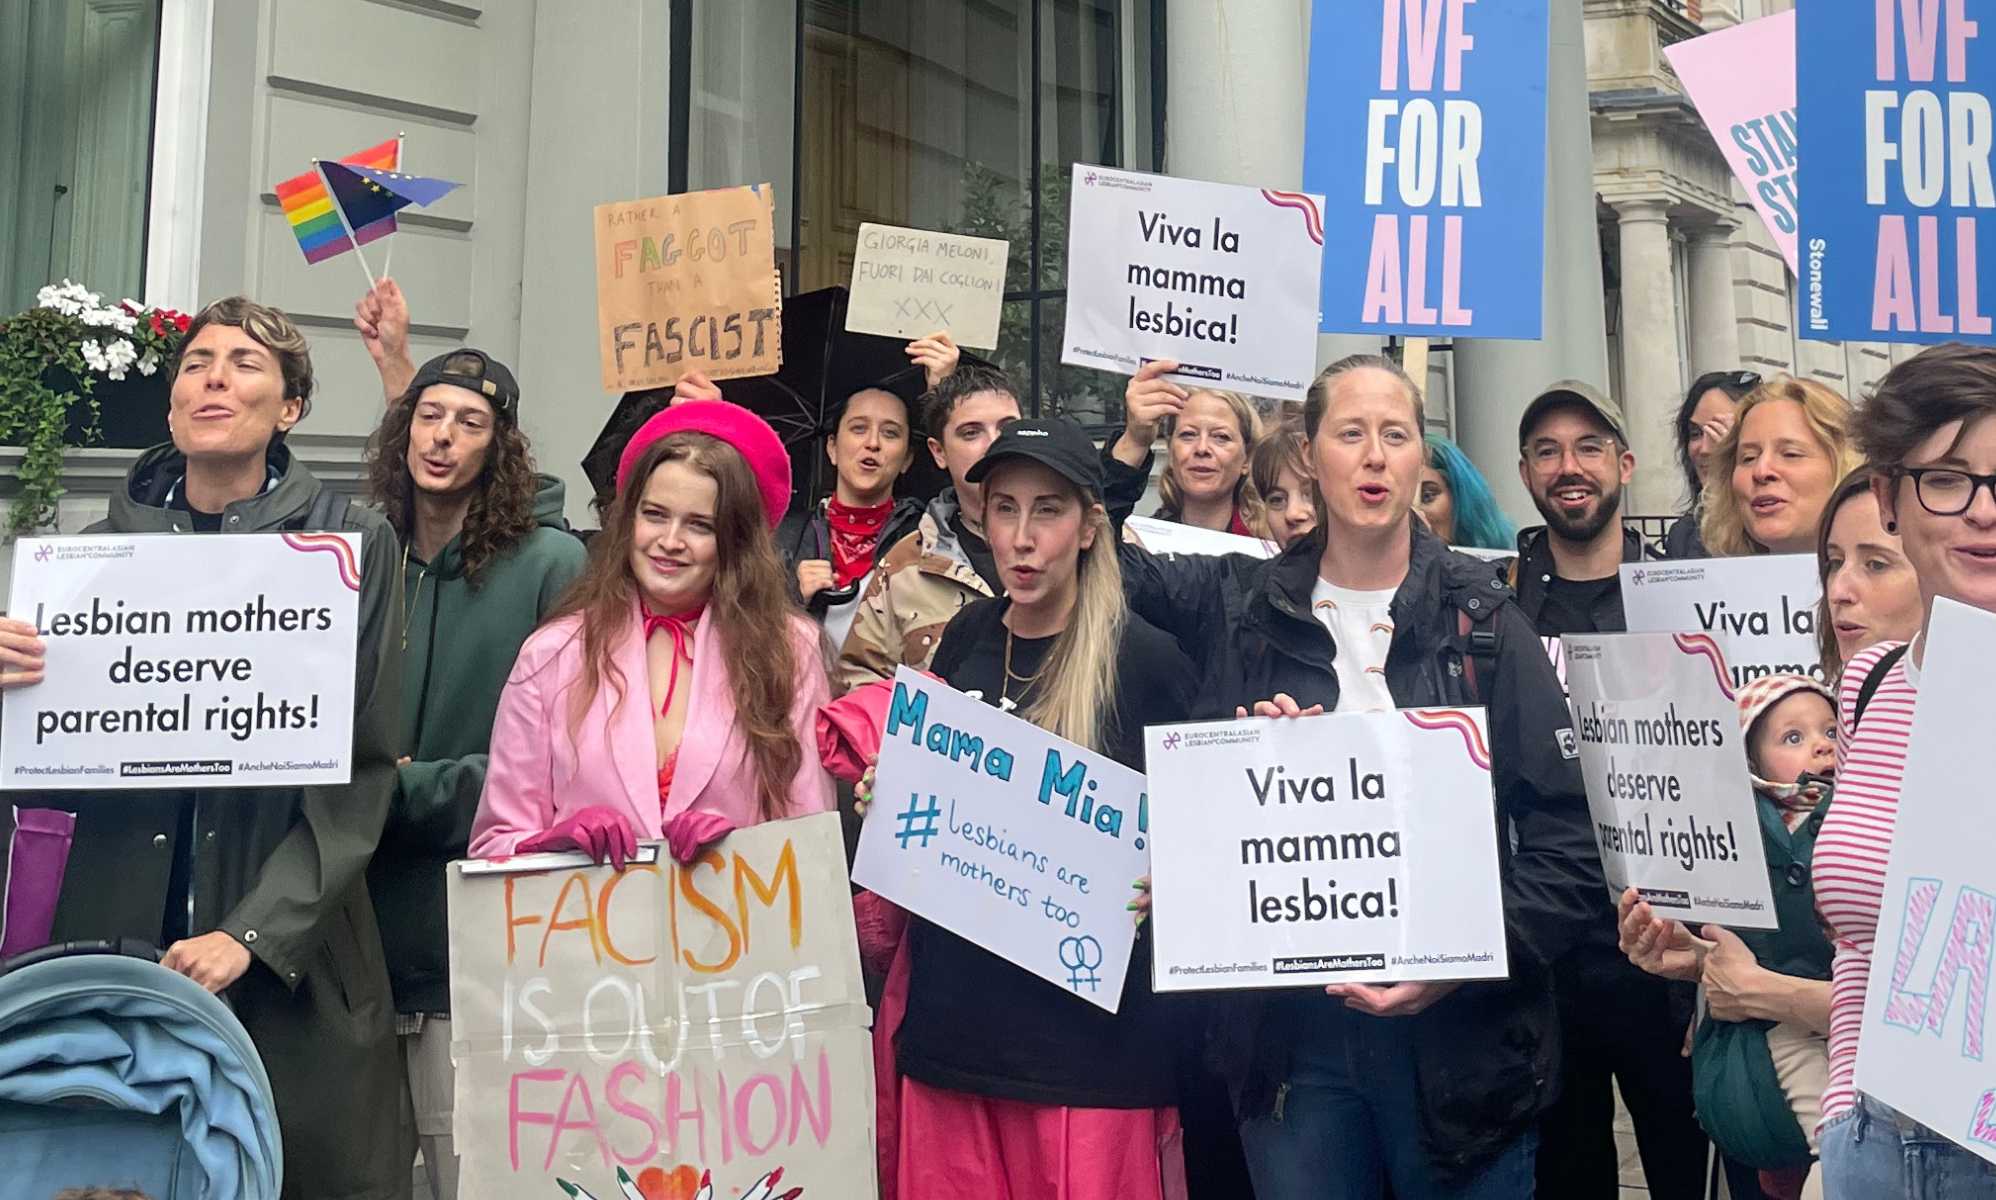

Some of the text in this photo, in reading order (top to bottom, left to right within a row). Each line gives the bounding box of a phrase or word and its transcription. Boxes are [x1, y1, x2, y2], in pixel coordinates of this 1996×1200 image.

[1380, 0, 1477, 91] IVF
[1875, 0, 1979, 82] IVF
[1364, 97, 1482, 208] FOR
[1864, 88, 1996, 209] FOR
[608, 207, 661, 228] RATHER
[1757, 170, 1797, 234] ST
[614, 219, 757, 279] FAGGOT
[863, 231, 929, 254] GIORGIA
[1138, 210, 1240, 254] Viva la
[859, 261, 903, 283] FUORI
[913, 266, 934, 284] DAI
[1127, 263, 1246, 300] mamma
[1361, 213, 1473, 326] ALL
[1809, 238, 1830, 331] Stonewall
[1871, 214, 1993, 335] ALL
[894, 297, 954, 326] XXX
[1129, 295, 1237, 344] lesbica!
[614, 307, 775, 374] FASCIST
[36, 594, 332, 637] Lesbian mothers
[1694, 595, 1814, 636] Viva la
[108, 646, 252, 684] deserve
[36, 692, 319, 745] parental rights!
[887, 682, 1014, 782] Mama
[1577, 701, 1723, 747] Lesbian mothers
[1246, 757, 1385, 806] Viva la
[1607, 755, 1681, 802] deserve
[1241, 831, 1401, 865] mamma
[1660, 815, 1739, 872] rights!
[503, 837, 802, 974] FACISM
[940, 850, 1081, 928] mothers too
[1057, 865, 1091, 895] are
[1249, 877, 1399, 923] lesbica!
[503, 972, 560, 1067] IS
[507, 1046, 833, 1172] FASHION
